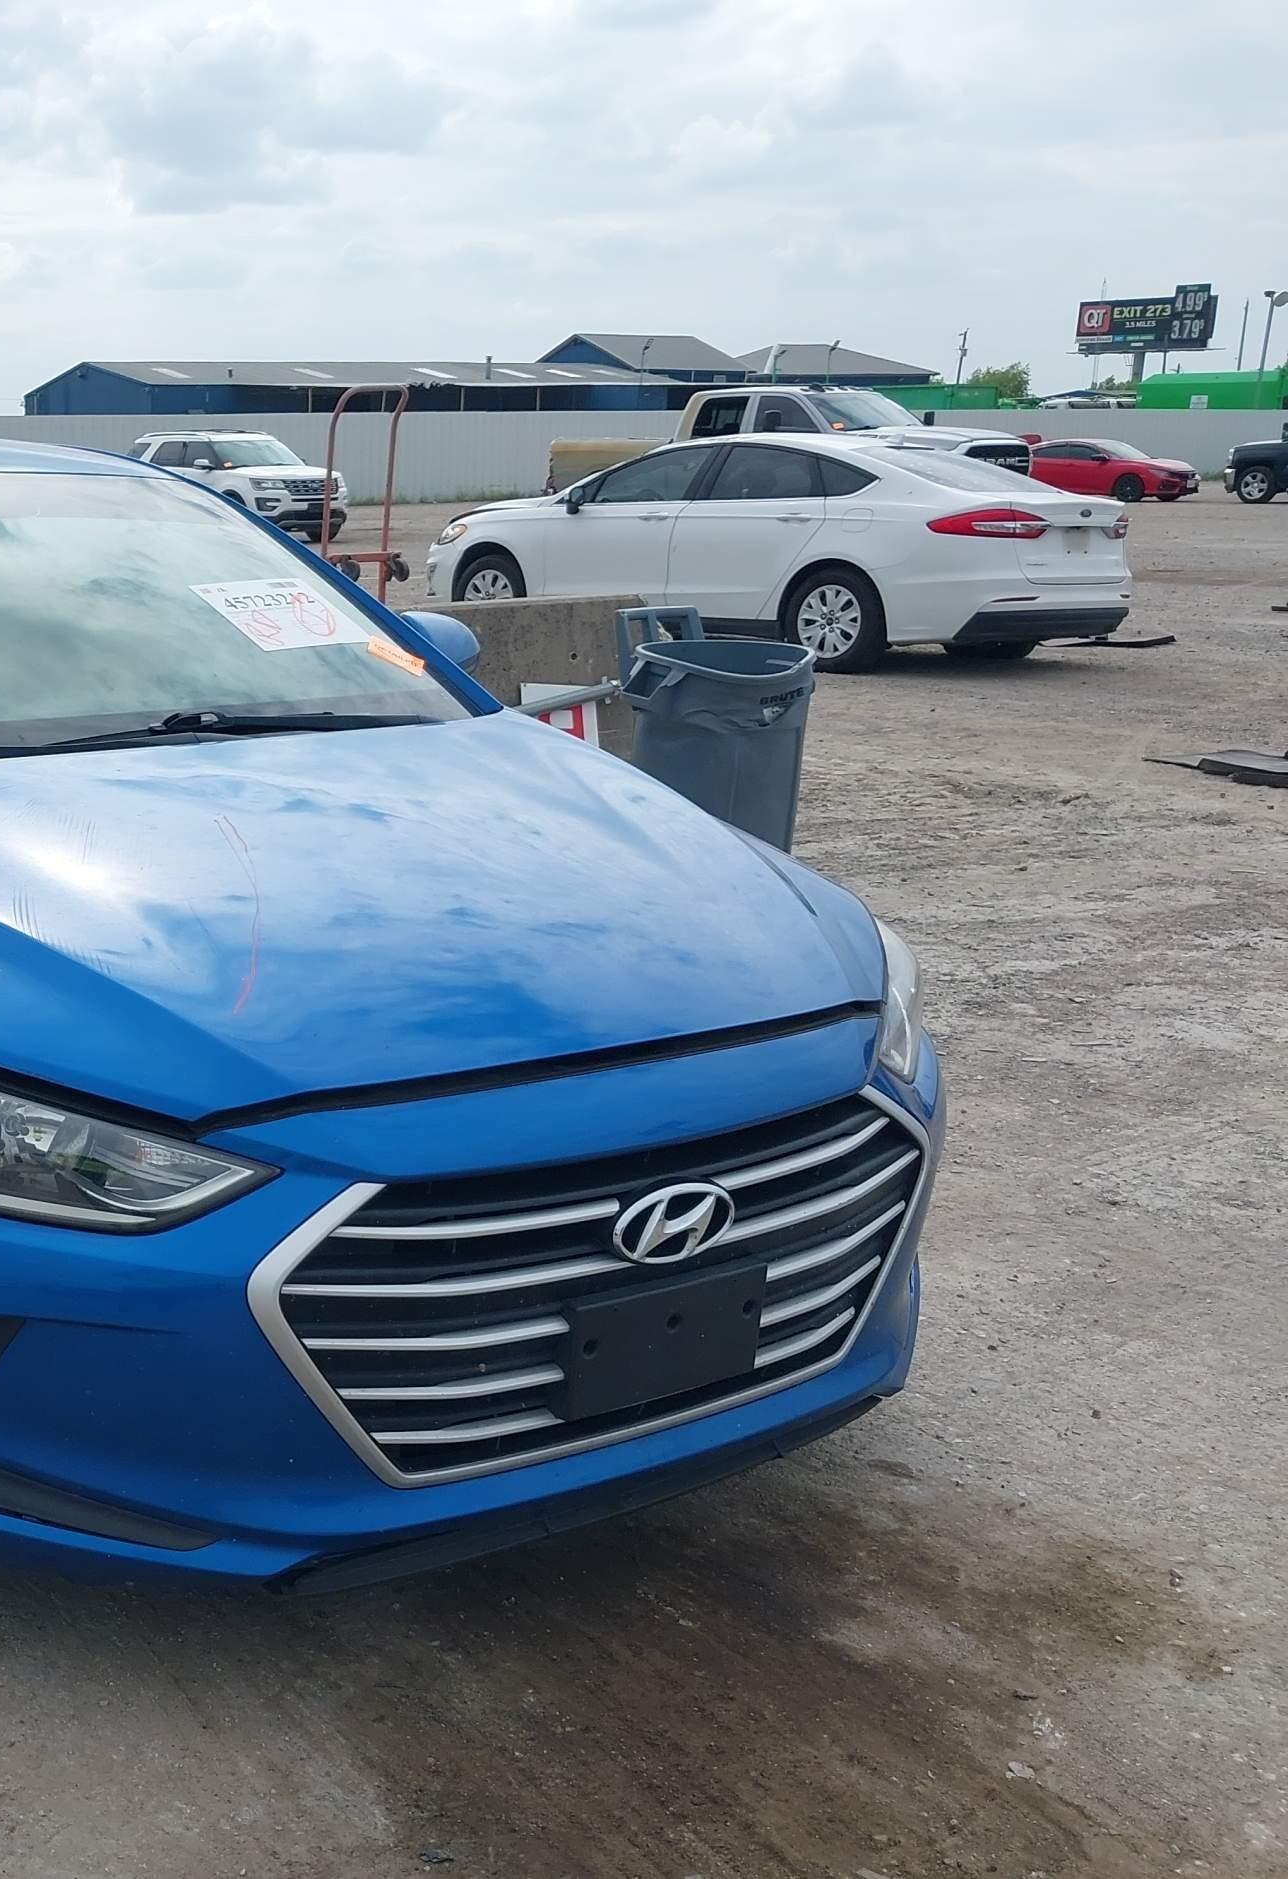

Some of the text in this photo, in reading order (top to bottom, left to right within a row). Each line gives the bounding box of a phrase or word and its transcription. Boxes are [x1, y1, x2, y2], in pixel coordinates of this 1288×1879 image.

[1084, 309, 1107, 328] QT
[1113, 304, 1172, 319] EXIT 273
